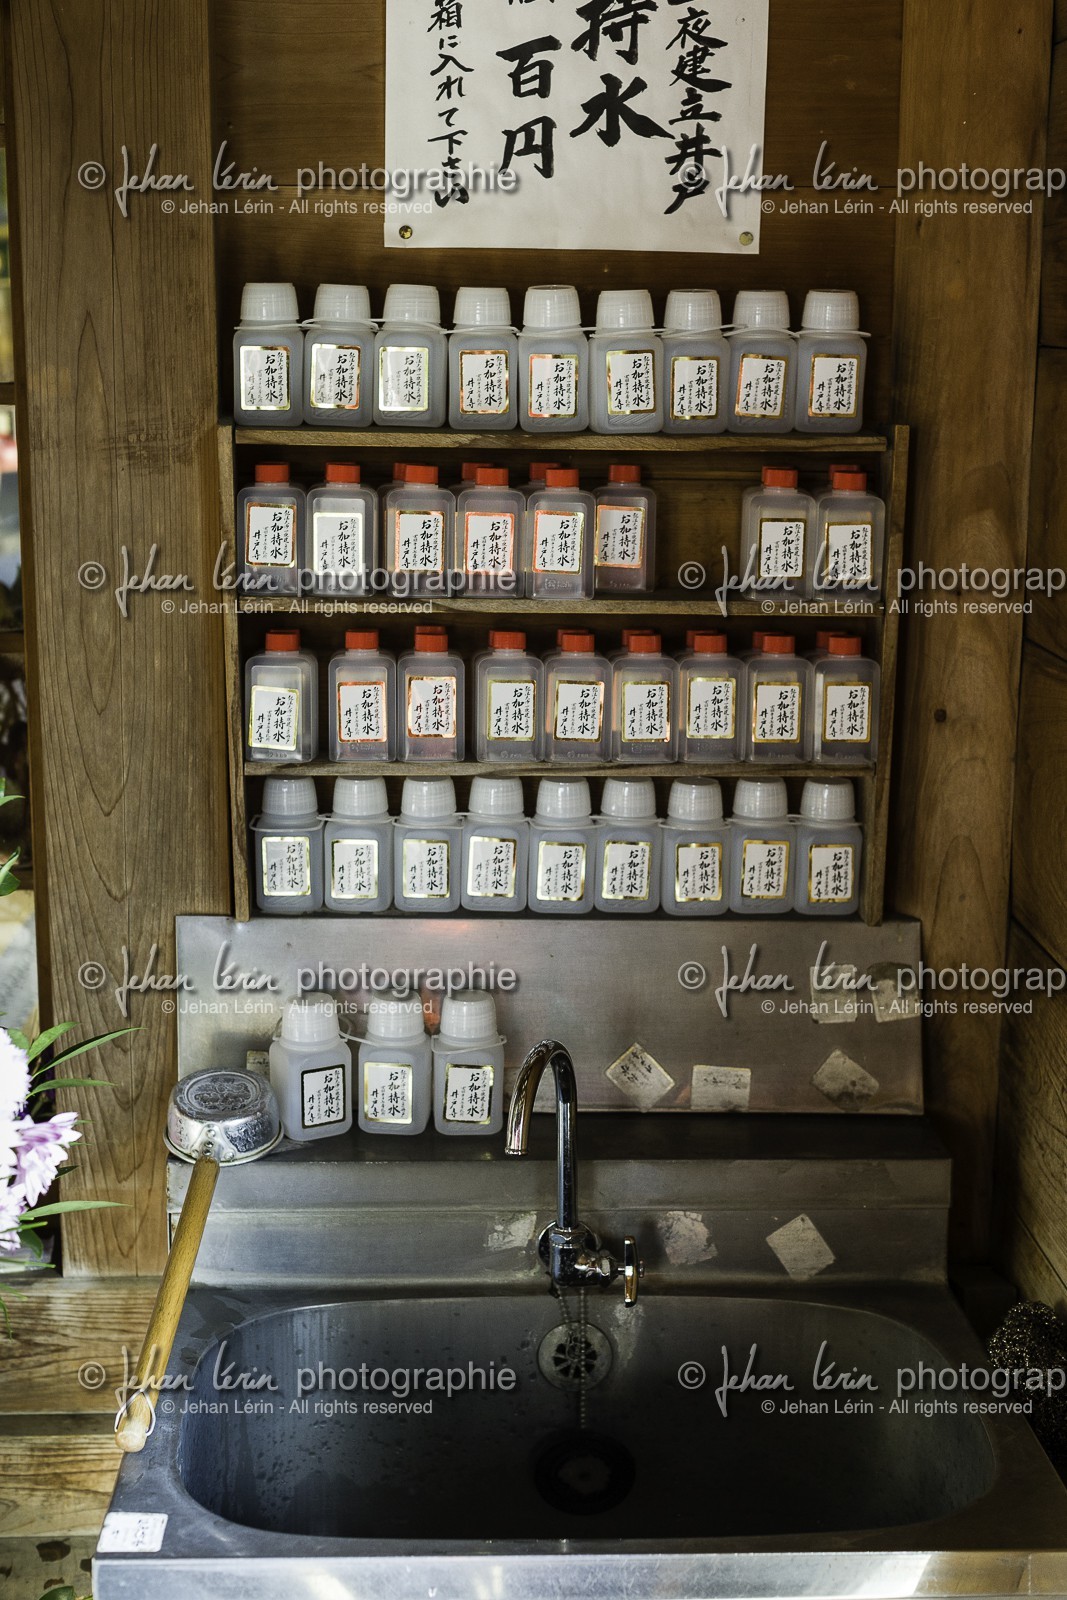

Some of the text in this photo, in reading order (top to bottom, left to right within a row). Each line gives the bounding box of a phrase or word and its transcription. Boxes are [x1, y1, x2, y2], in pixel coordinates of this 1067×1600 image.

[497, 0, 562, 179] 百円
[264, 354, 278, 403] お加持水
[334, 354, 348, 402] お加持水
[403, 355, 416, 403] お加持水
[484, 358, 497, 406] お加持水
[552, 363, 566, 410] お加持水
[632, 358, 646, 407] お加持水
[694, 365, 708, 413] お加持水
[759, 363, 775, 411] お加持水
[833, 363, 848, 411] お加持水
[270, 512, 284, 559] お加持水
[338, 520, 351, 567] お加持水
[420, 519, 433, 567] お加持水
[488, 521, 502, 567] お加持水
[557, 519, 571, 566] お加持水
[618, 514, 632, 561] お加持水
[781, 525, 795, 572] お加持水
[849, 529, 862, 576] お加持水
[273, 696, 287, 742] お加持水
[361, 689, 375, 735] お加持水
[431, 685, 445, 731] お加持水
[511, 688, 525, 734] お加持水
[577, 688, 592, 734] お加持水
[645, 688, 659, 735] お加持水
[710, 685, 723, 731] お加持水
[776, 690, 789, 736] お加持水
[846, 689, 860, 736] お加持水
[323, 1073, 336, 1118] お加持水
[388, 1072, 400, 1116] お加持水
[466, 1073, 481, 1117] お加持水
